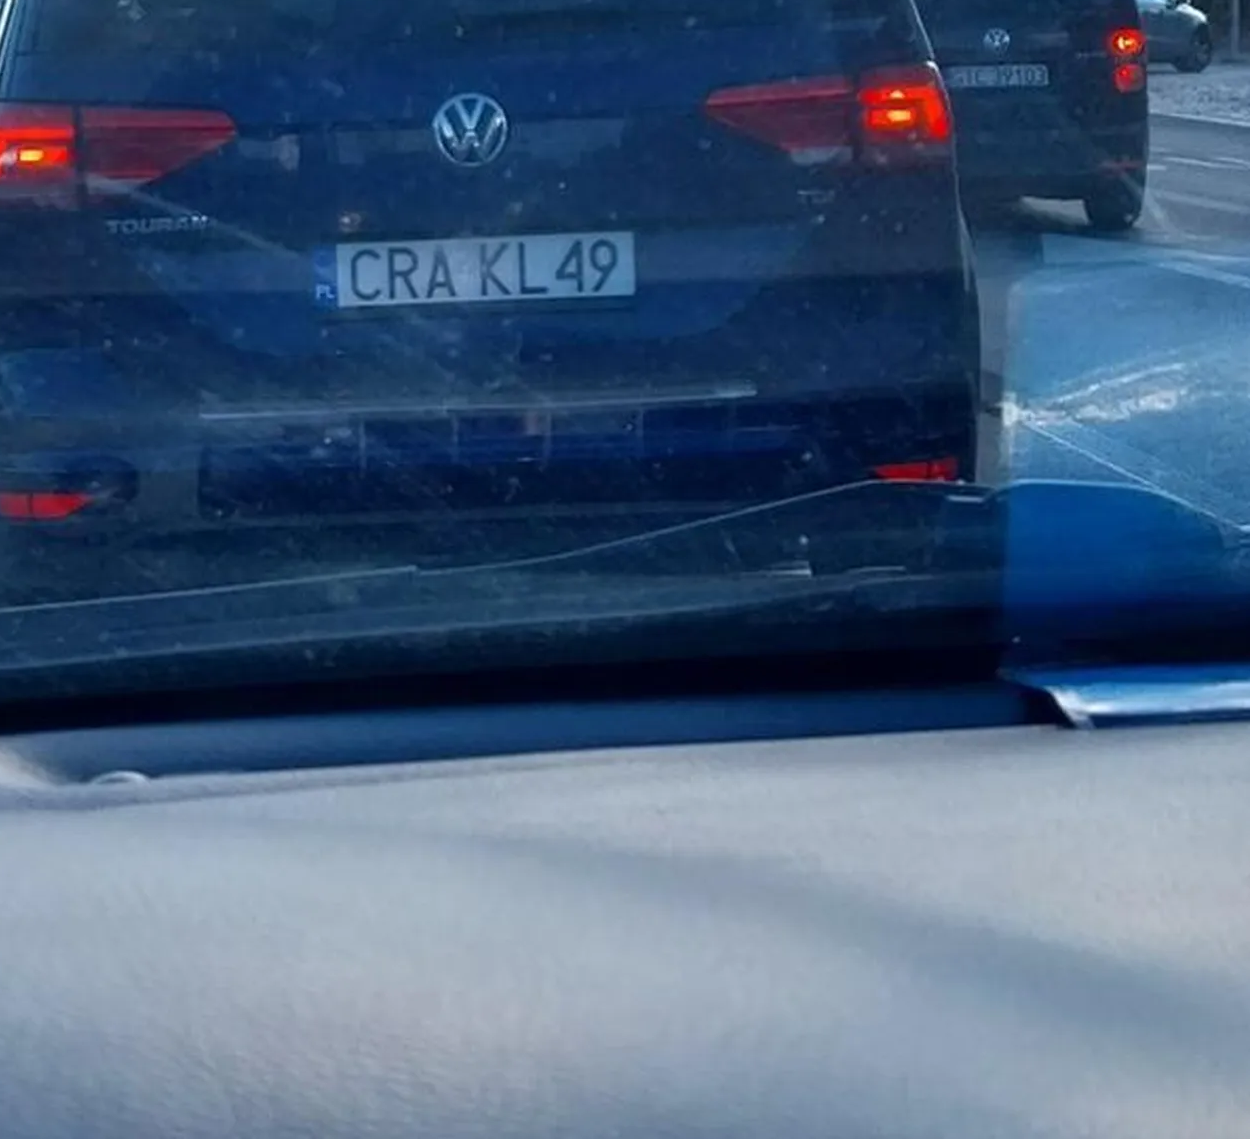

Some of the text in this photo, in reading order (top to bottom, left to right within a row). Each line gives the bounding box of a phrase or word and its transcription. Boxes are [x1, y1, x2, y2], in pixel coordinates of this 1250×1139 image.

[432, 93, 508, 167] VW
[315, 284, 335, 299] PL
[350, 238, 618, 301] CRA KL49
